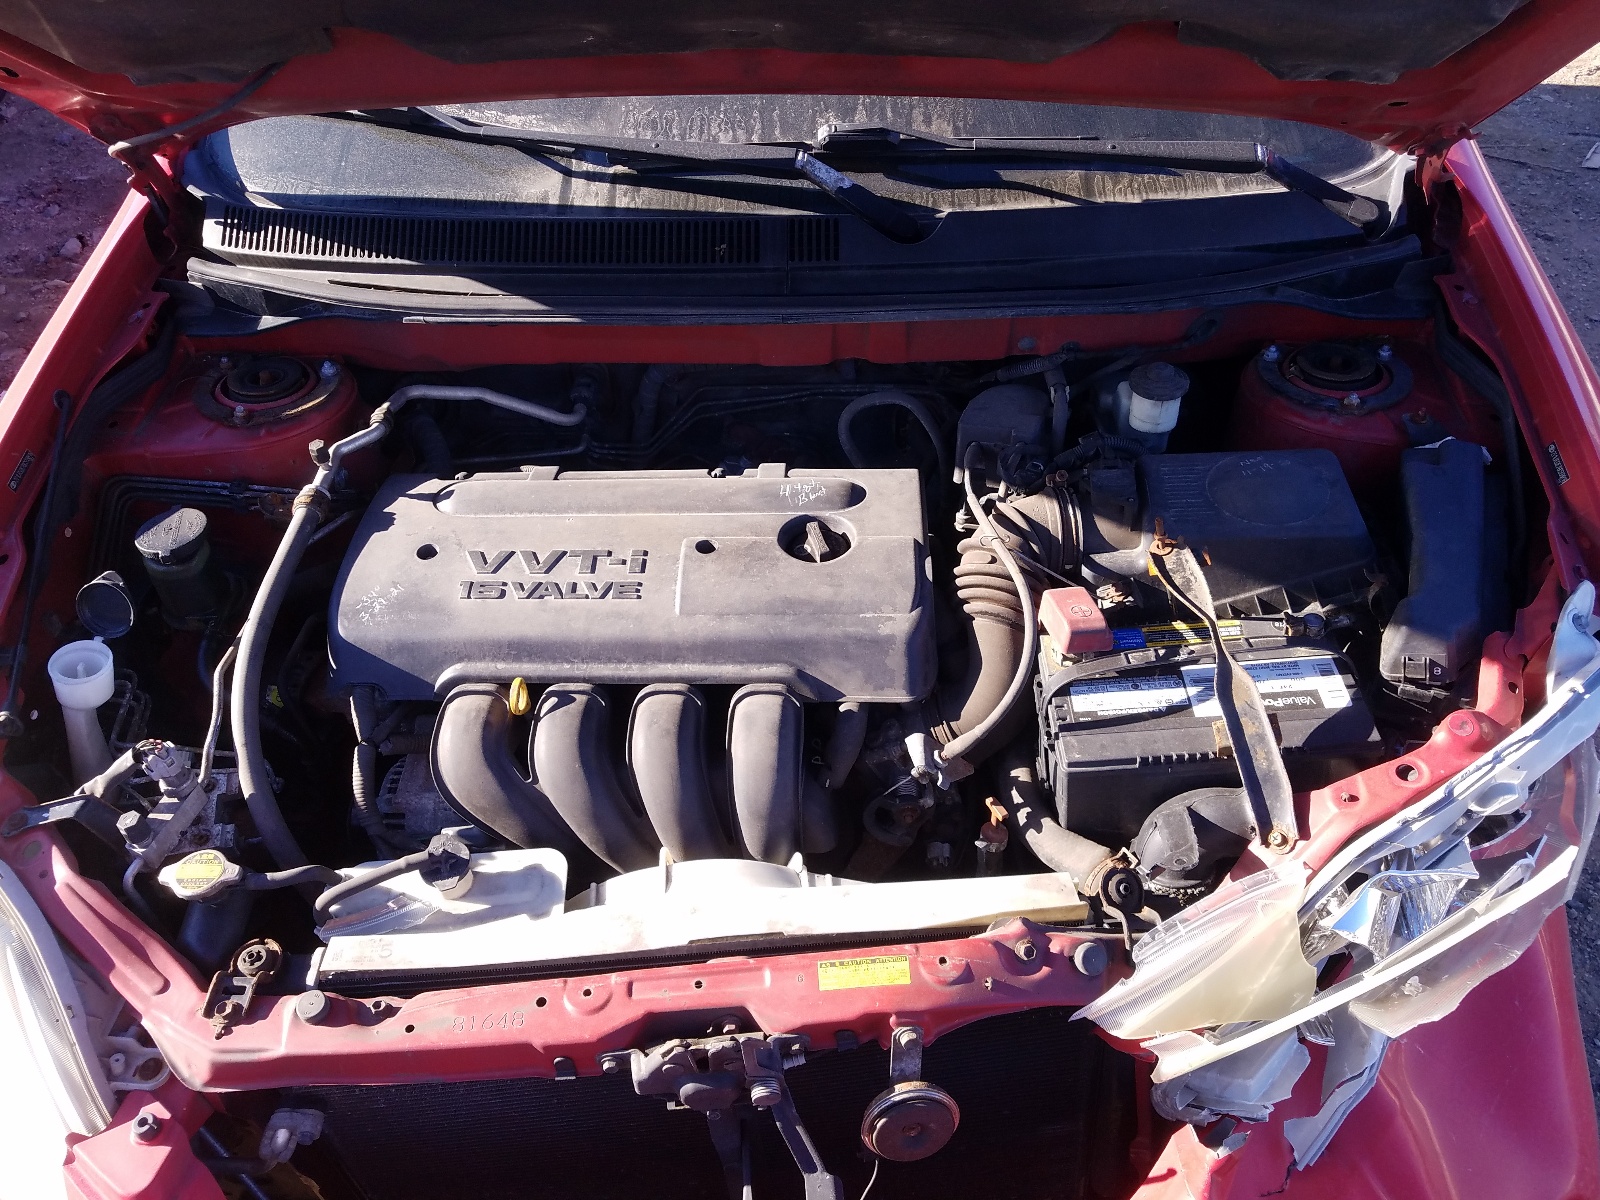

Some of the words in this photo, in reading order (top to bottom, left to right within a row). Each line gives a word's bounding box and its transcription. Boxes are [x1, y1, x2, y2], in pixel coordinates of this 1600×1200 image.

[465, 549, 649, 574] VVT-i
[459, 580, 508, 600] 16
[511, 581, 644, 600] VALVE
[876, 956, 906, 964] ATTENTION
[452, 1010, 525, 1033] 81648
